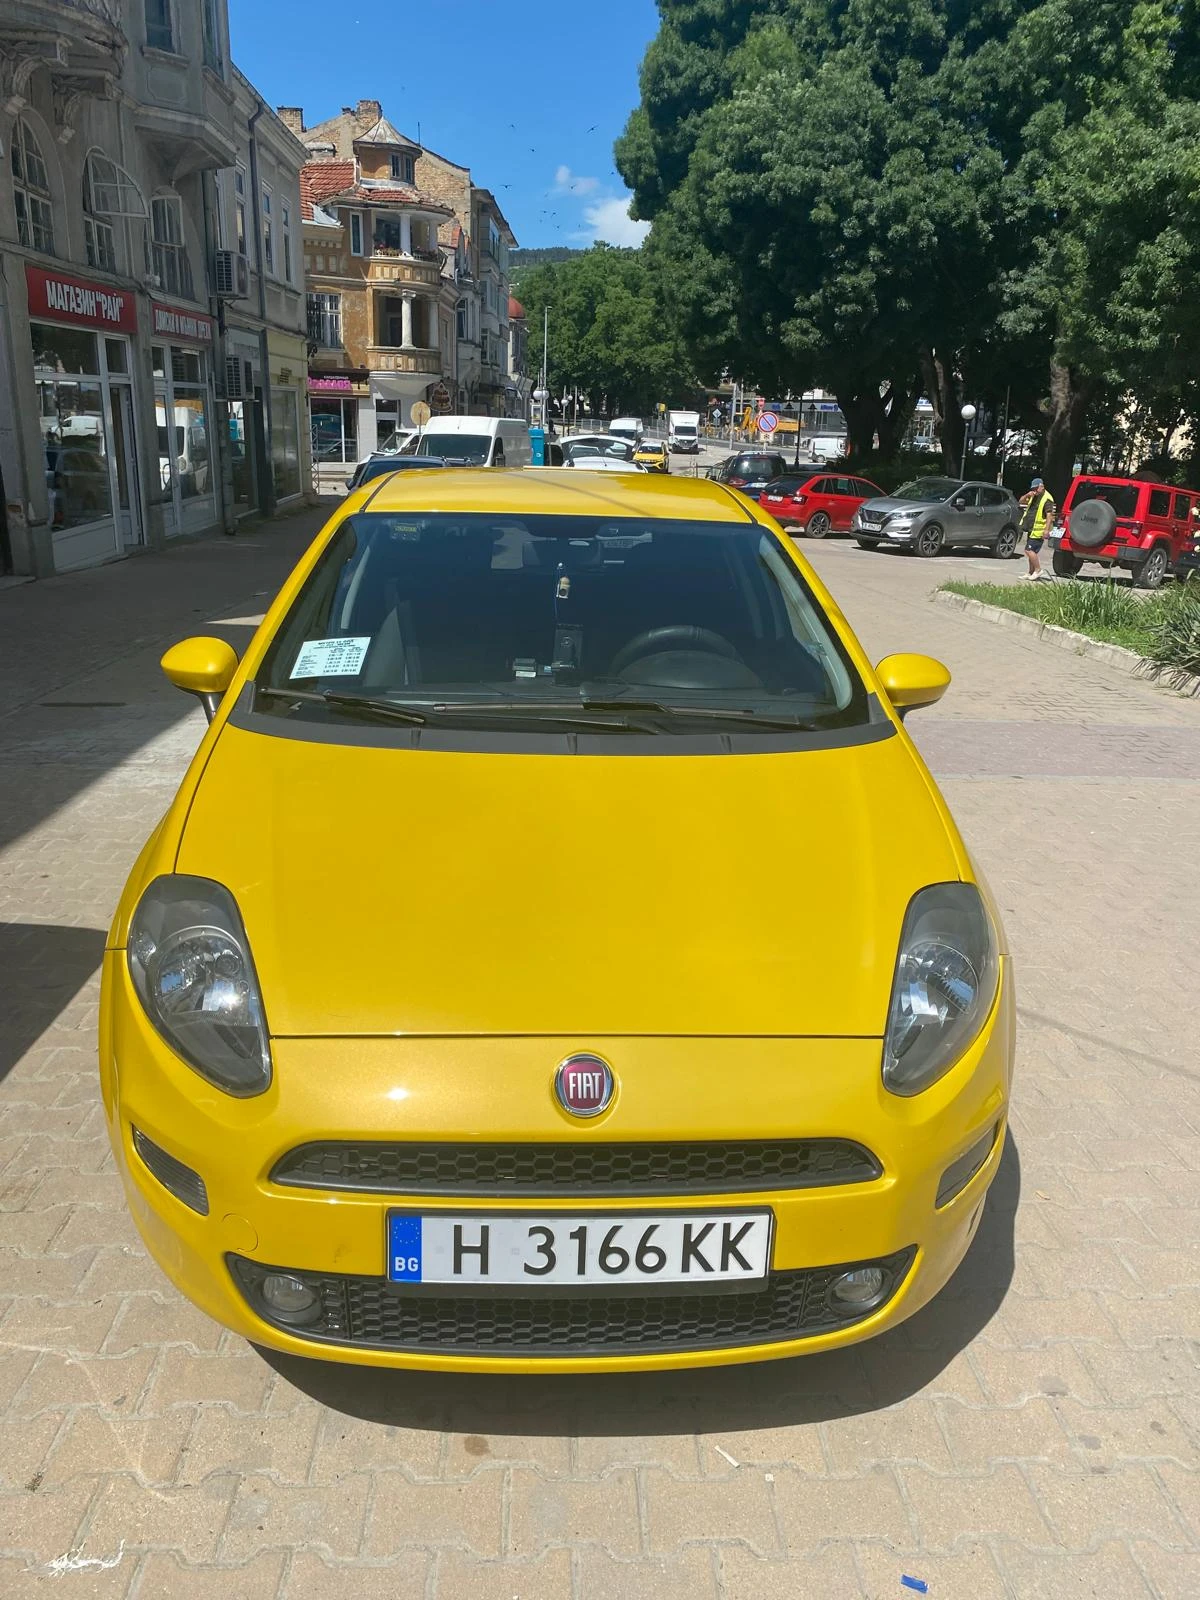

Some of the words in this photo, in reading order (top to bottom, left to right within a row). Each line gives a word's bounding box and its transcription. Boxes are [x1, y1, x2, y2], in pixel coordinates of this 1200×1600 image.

[46, 280, 97, 317] МАГАЗИН
[569, 1072, 601, 1099] FIAT
[395, 1256, 419, 1272] BG
